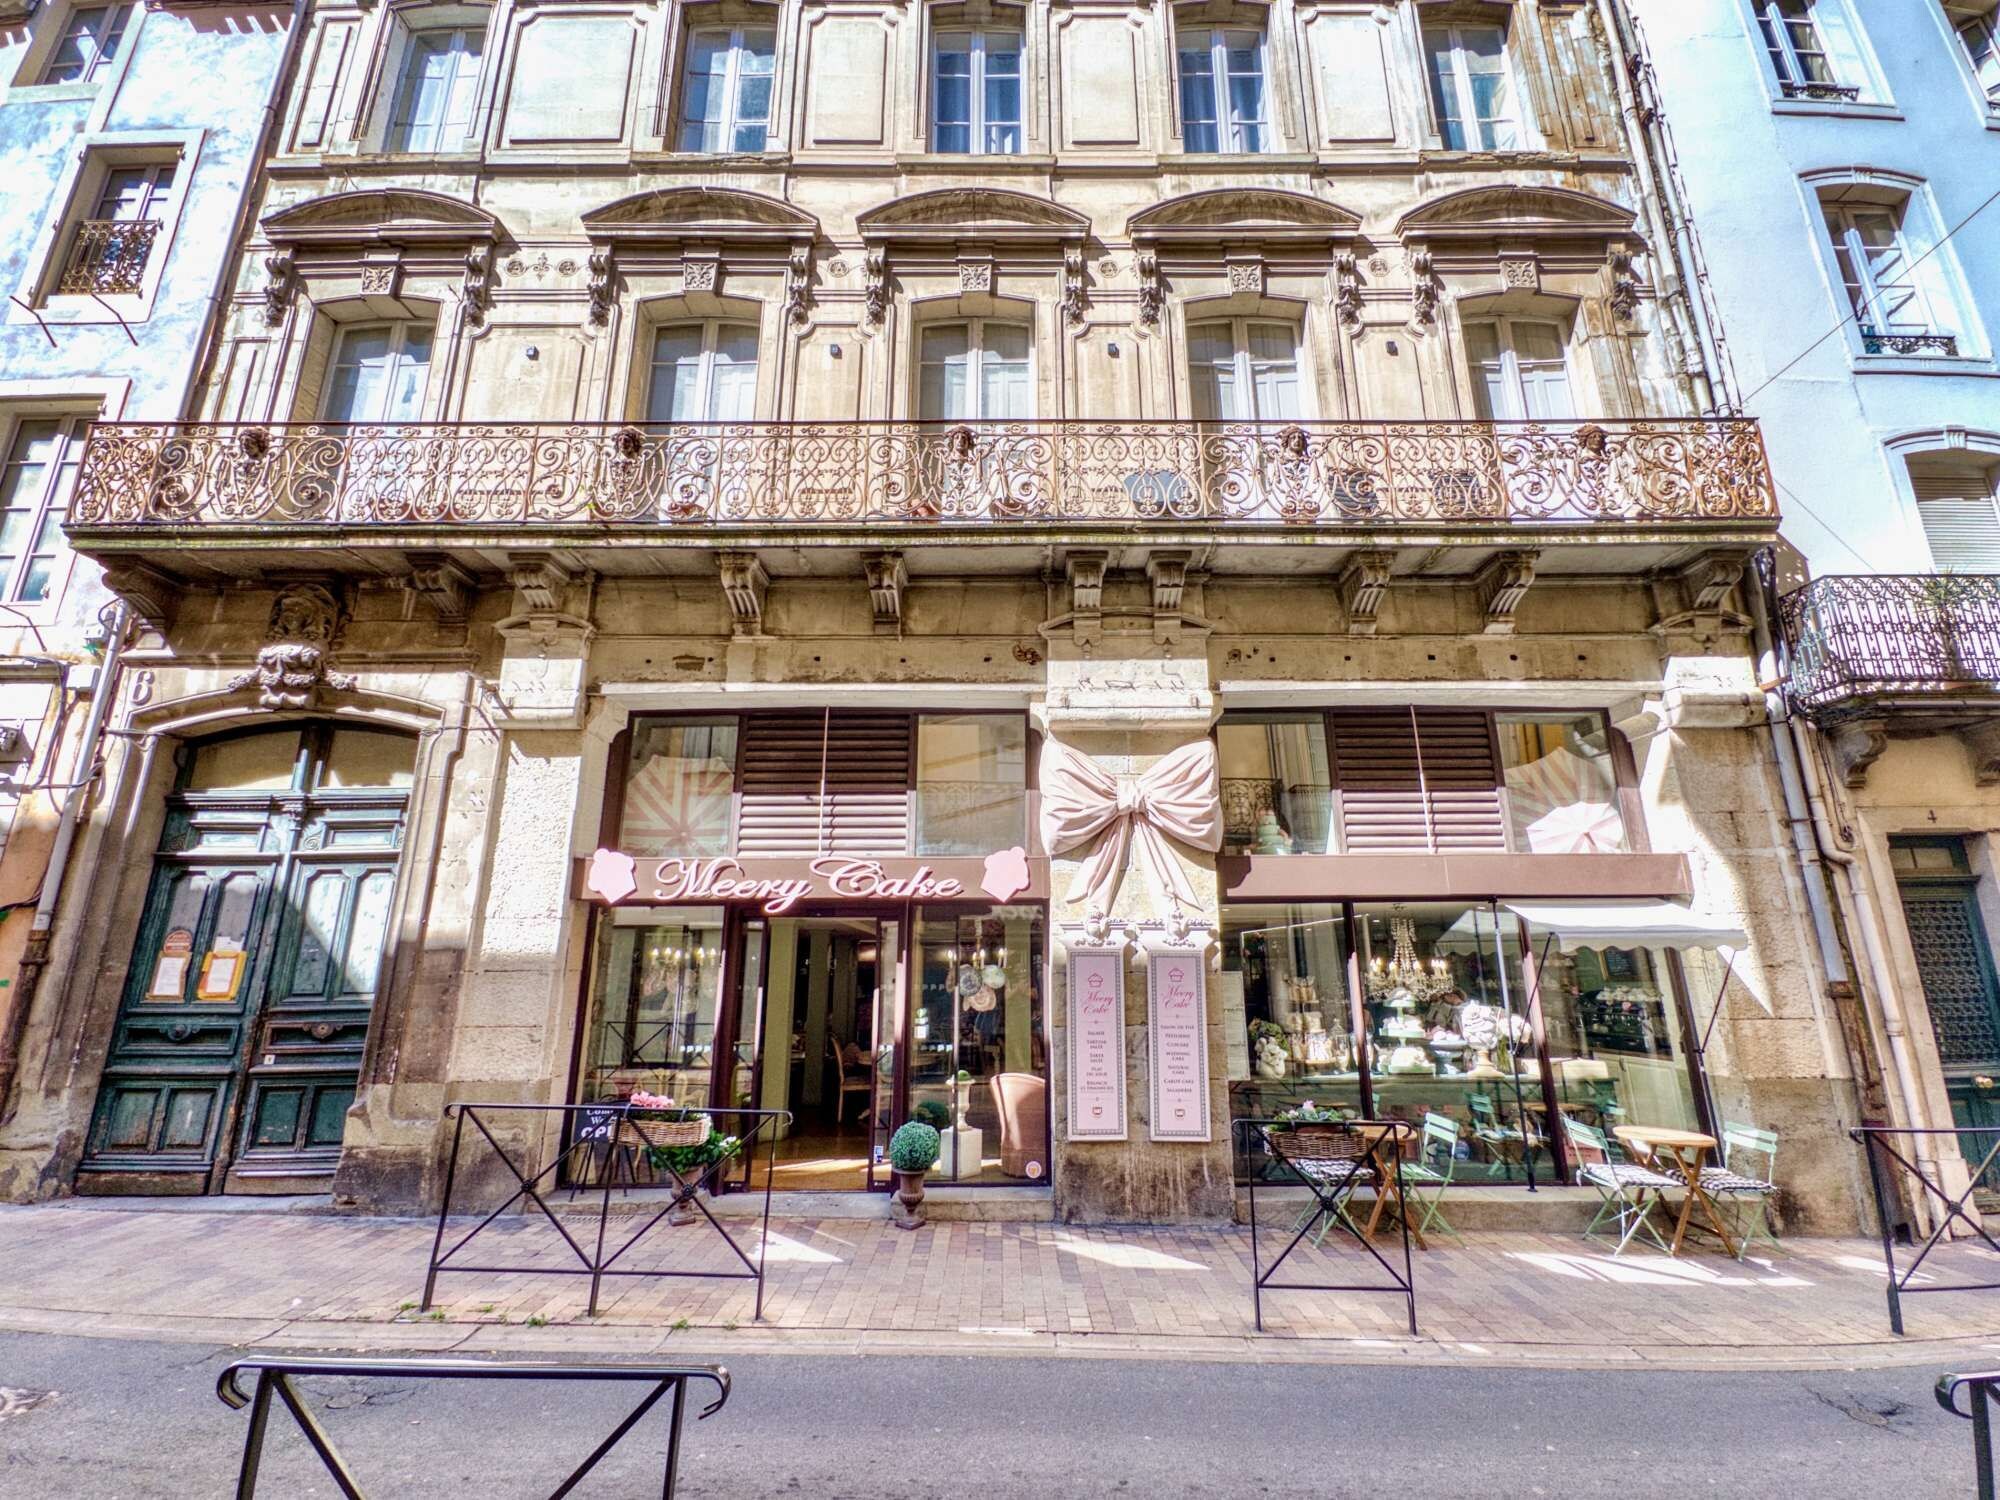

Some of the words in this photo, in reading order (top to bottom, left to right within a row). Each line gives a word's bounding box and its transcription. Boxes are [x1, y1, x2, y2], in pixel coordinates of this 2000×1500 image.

[131, 670, 155, 706] 6
[1927, 809, 1937, 824] 4
[654, 857, 813, 914] Meery
[809, 856, 962, 898] Cake
